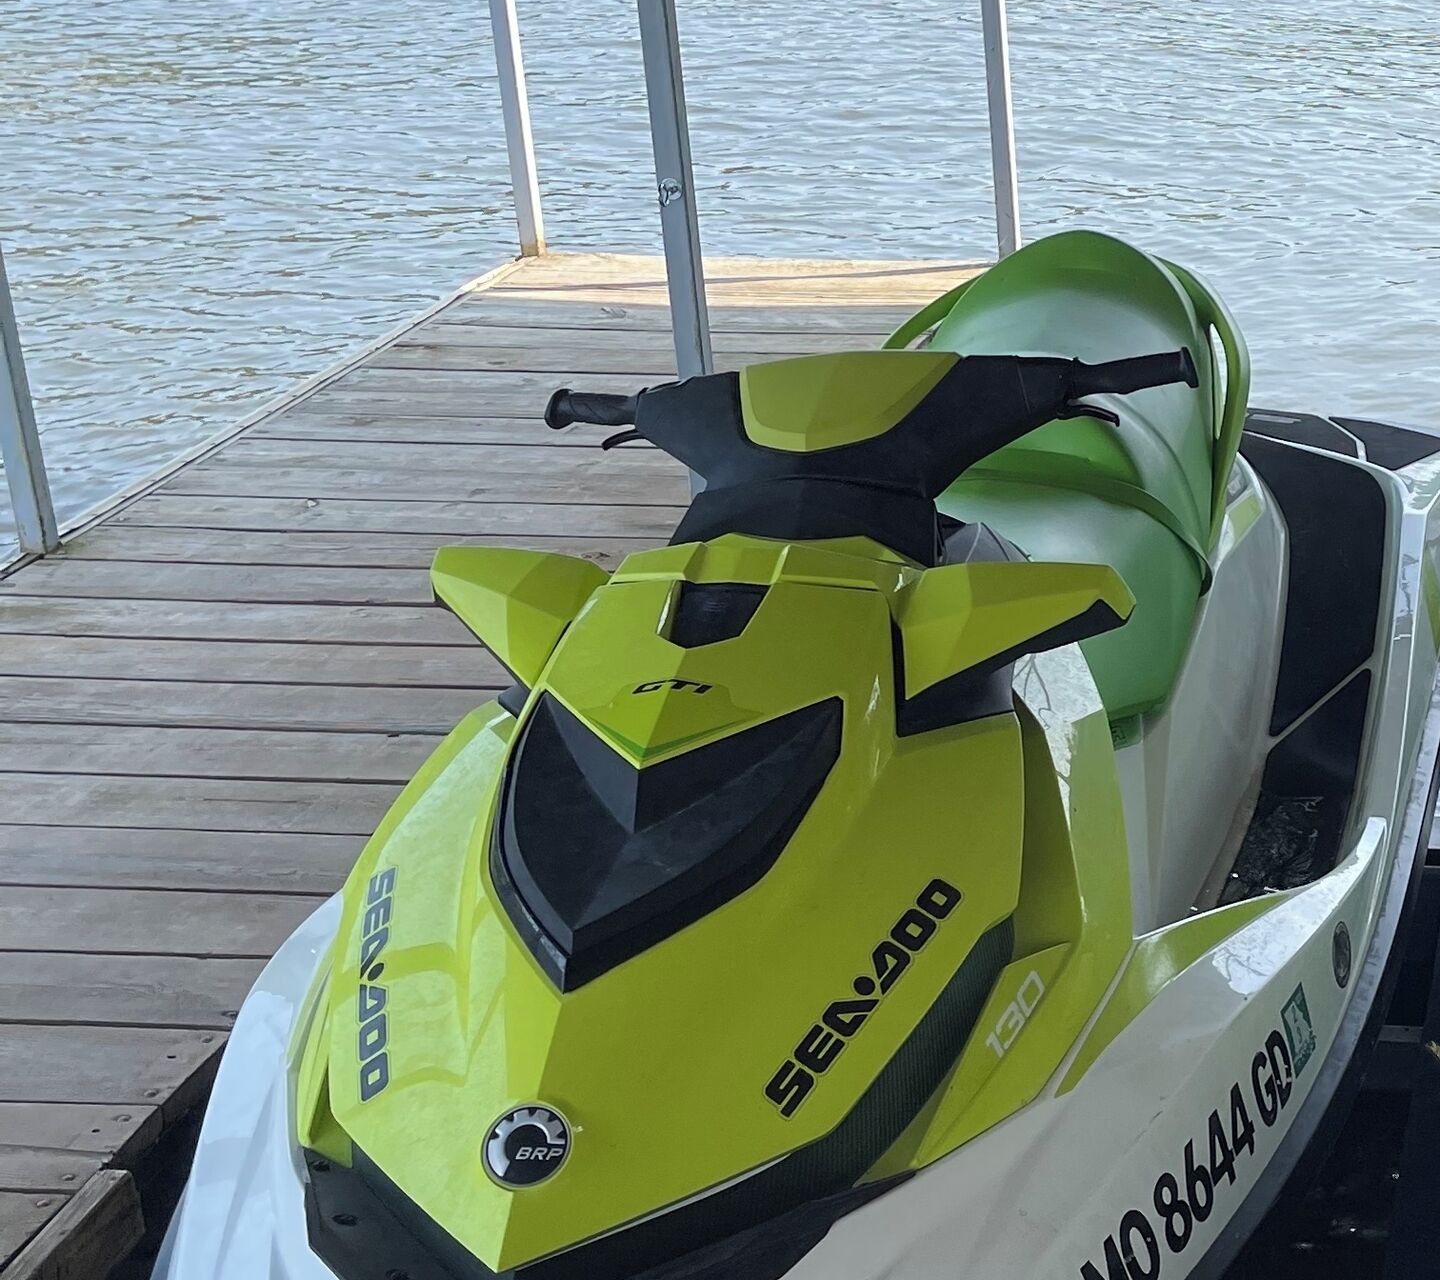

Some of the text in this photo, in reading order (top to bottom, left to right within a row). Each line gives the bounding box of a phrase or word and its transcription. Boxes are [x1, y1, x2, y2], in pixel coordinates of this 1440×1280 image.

[632, 678, 713, 695] GTI
[985, 970, 1045, 1058] 130
[515, 1146, 564, 1161] BRP
[1153, 1081, 1255, 1253] 8644
[1251, 1029, 1293, 1127] GD
